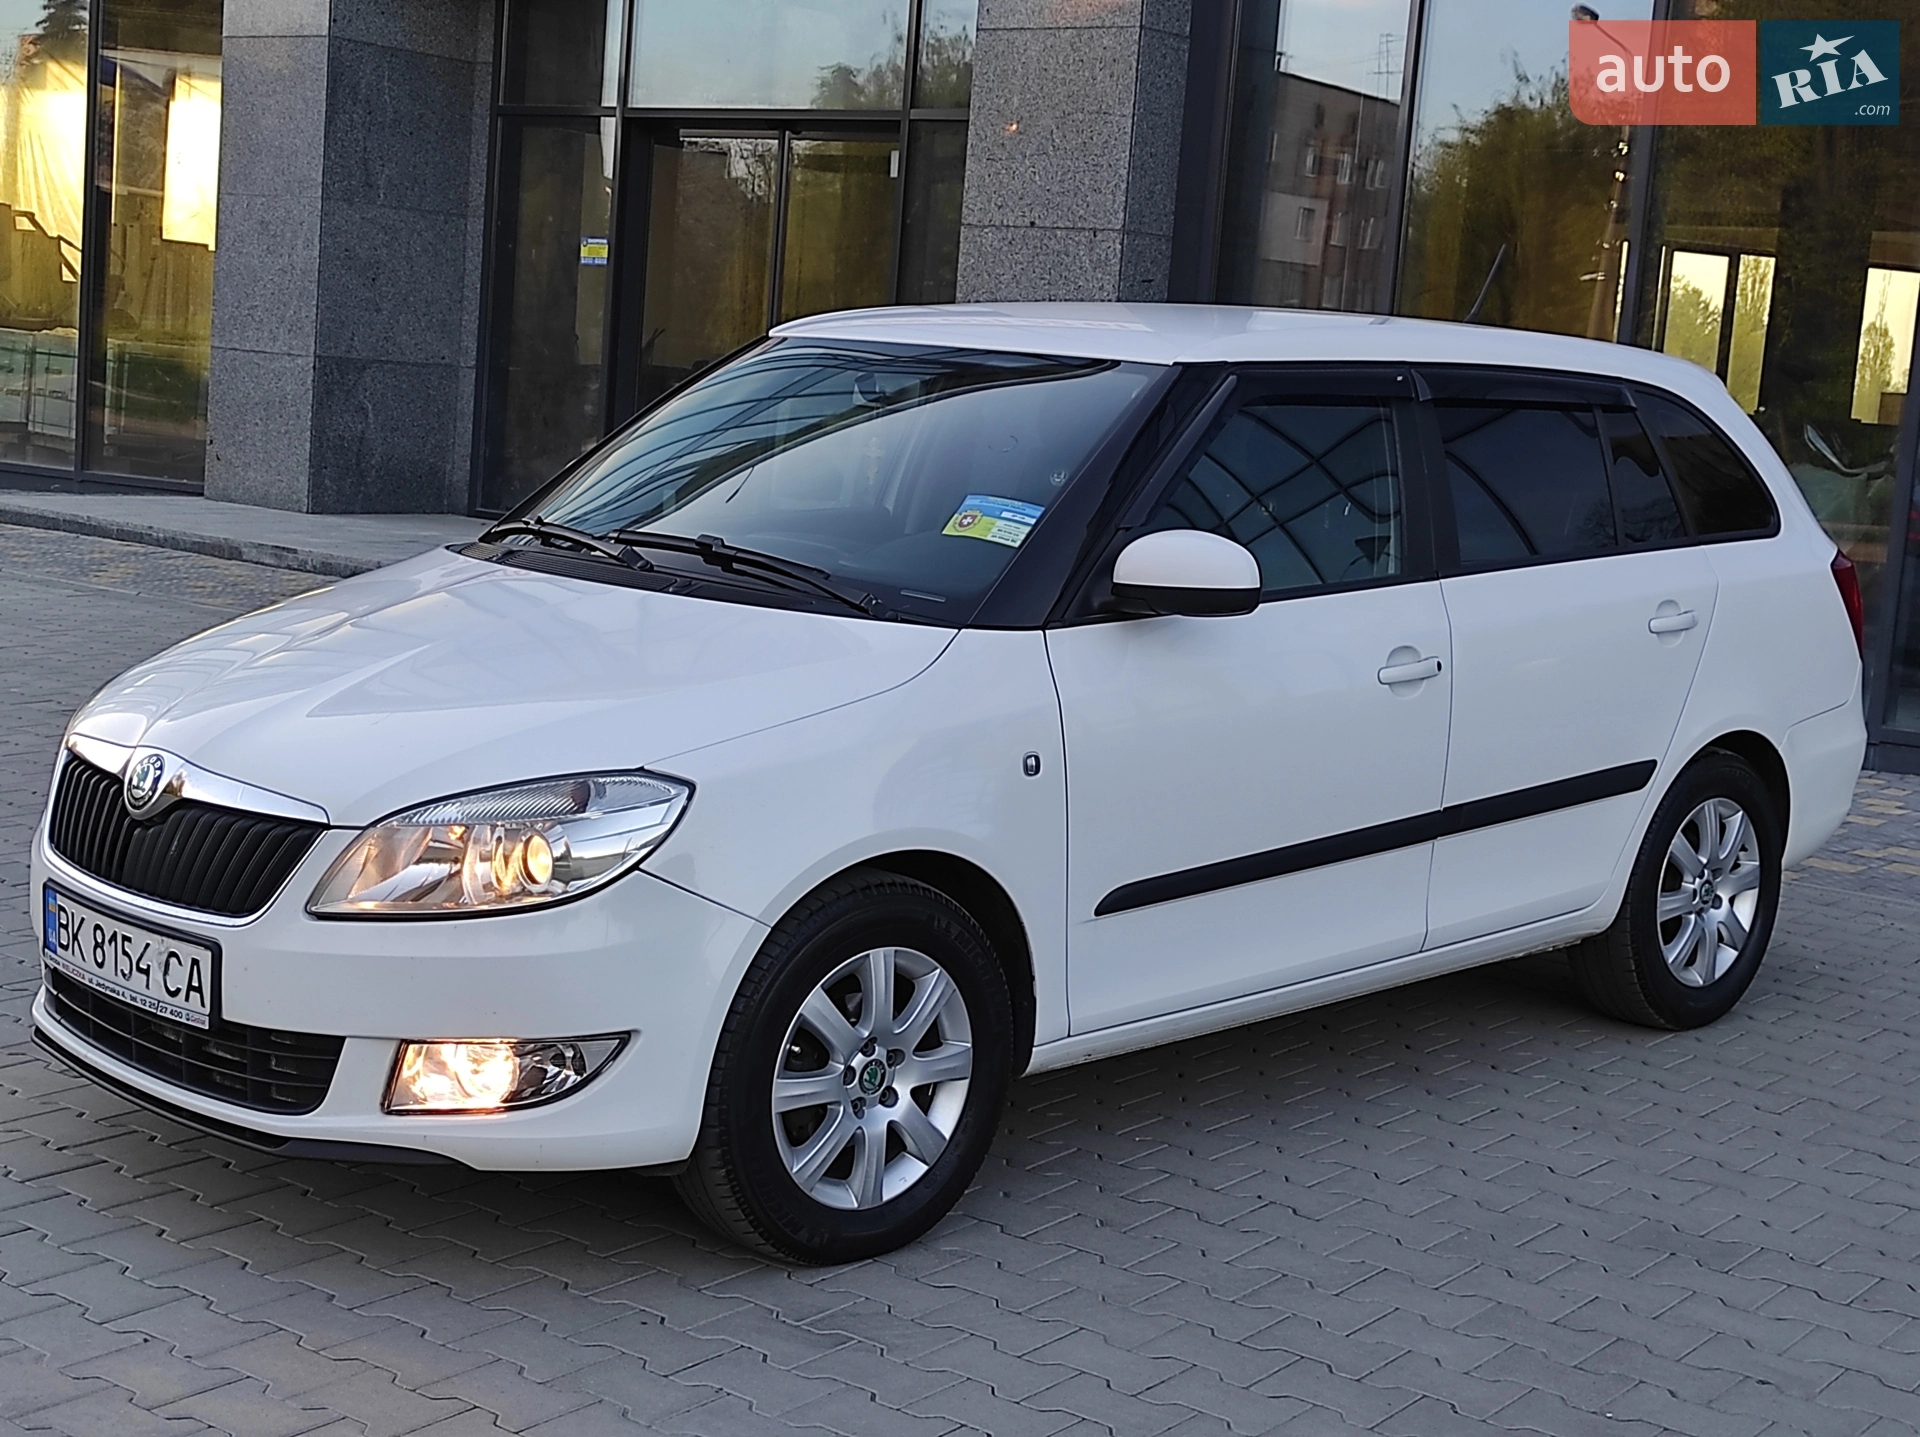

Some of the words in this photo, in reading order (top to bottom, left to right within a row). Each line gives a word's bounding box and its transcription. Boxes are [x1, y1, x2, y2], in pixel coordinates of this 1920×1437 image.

[57, 903, 87, 963] BK
[93, 922, 151, 990] 8154
[163, 950, 206, 1009] CA
[139, 998, 147, 1007] 12
[159, 1005, 168, 1014] 27
[169, 1009, 183, 1019] 400
